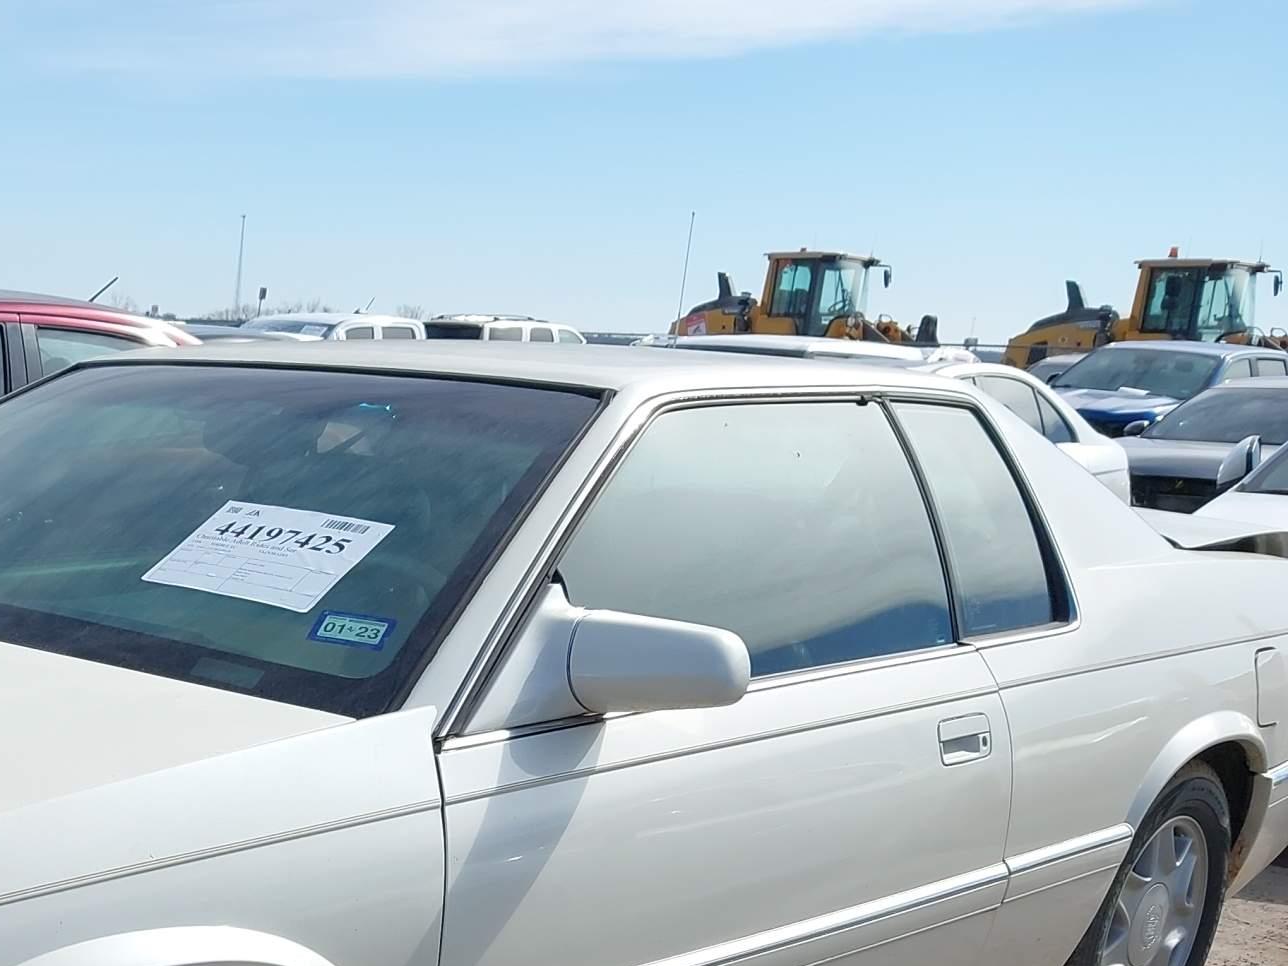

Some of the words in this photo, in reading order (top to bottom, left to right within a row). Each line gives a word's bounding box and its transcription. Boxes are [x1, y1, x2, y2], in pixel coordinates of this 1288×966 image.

[215, 521, 353, 554] 44197425
[323, 621, 346, 635] 01
[355, 625, 381, 640] 23
